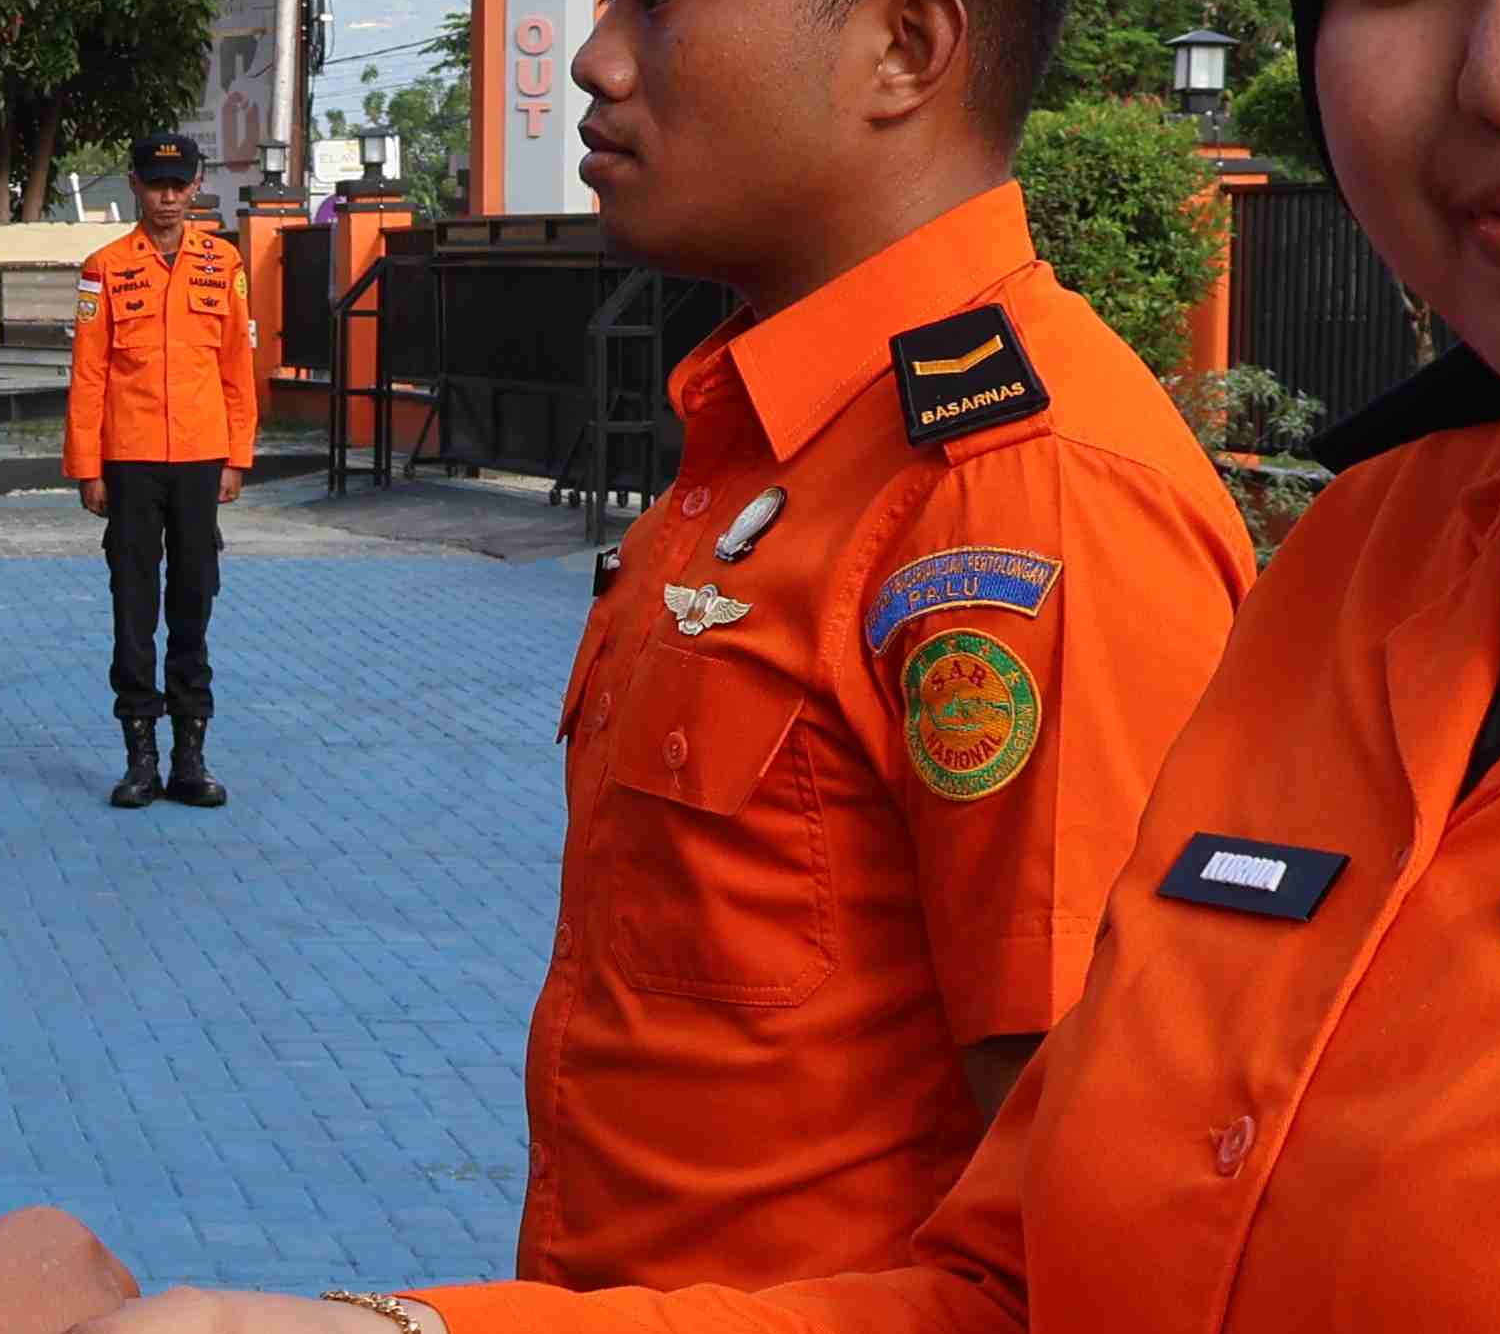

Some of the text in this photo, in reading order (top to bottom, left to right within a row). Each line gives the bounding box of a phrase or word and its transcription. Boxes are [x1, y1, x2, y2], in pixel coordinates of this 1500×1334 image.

[515, 16, 553, 138] OUT
[920, 381, 1026, 425] BASARNAS
[908, 575, 980, 610] PALU
[930, 660, 990, 693] SAR
[925, 730, 1003, 770] NASIONAL
